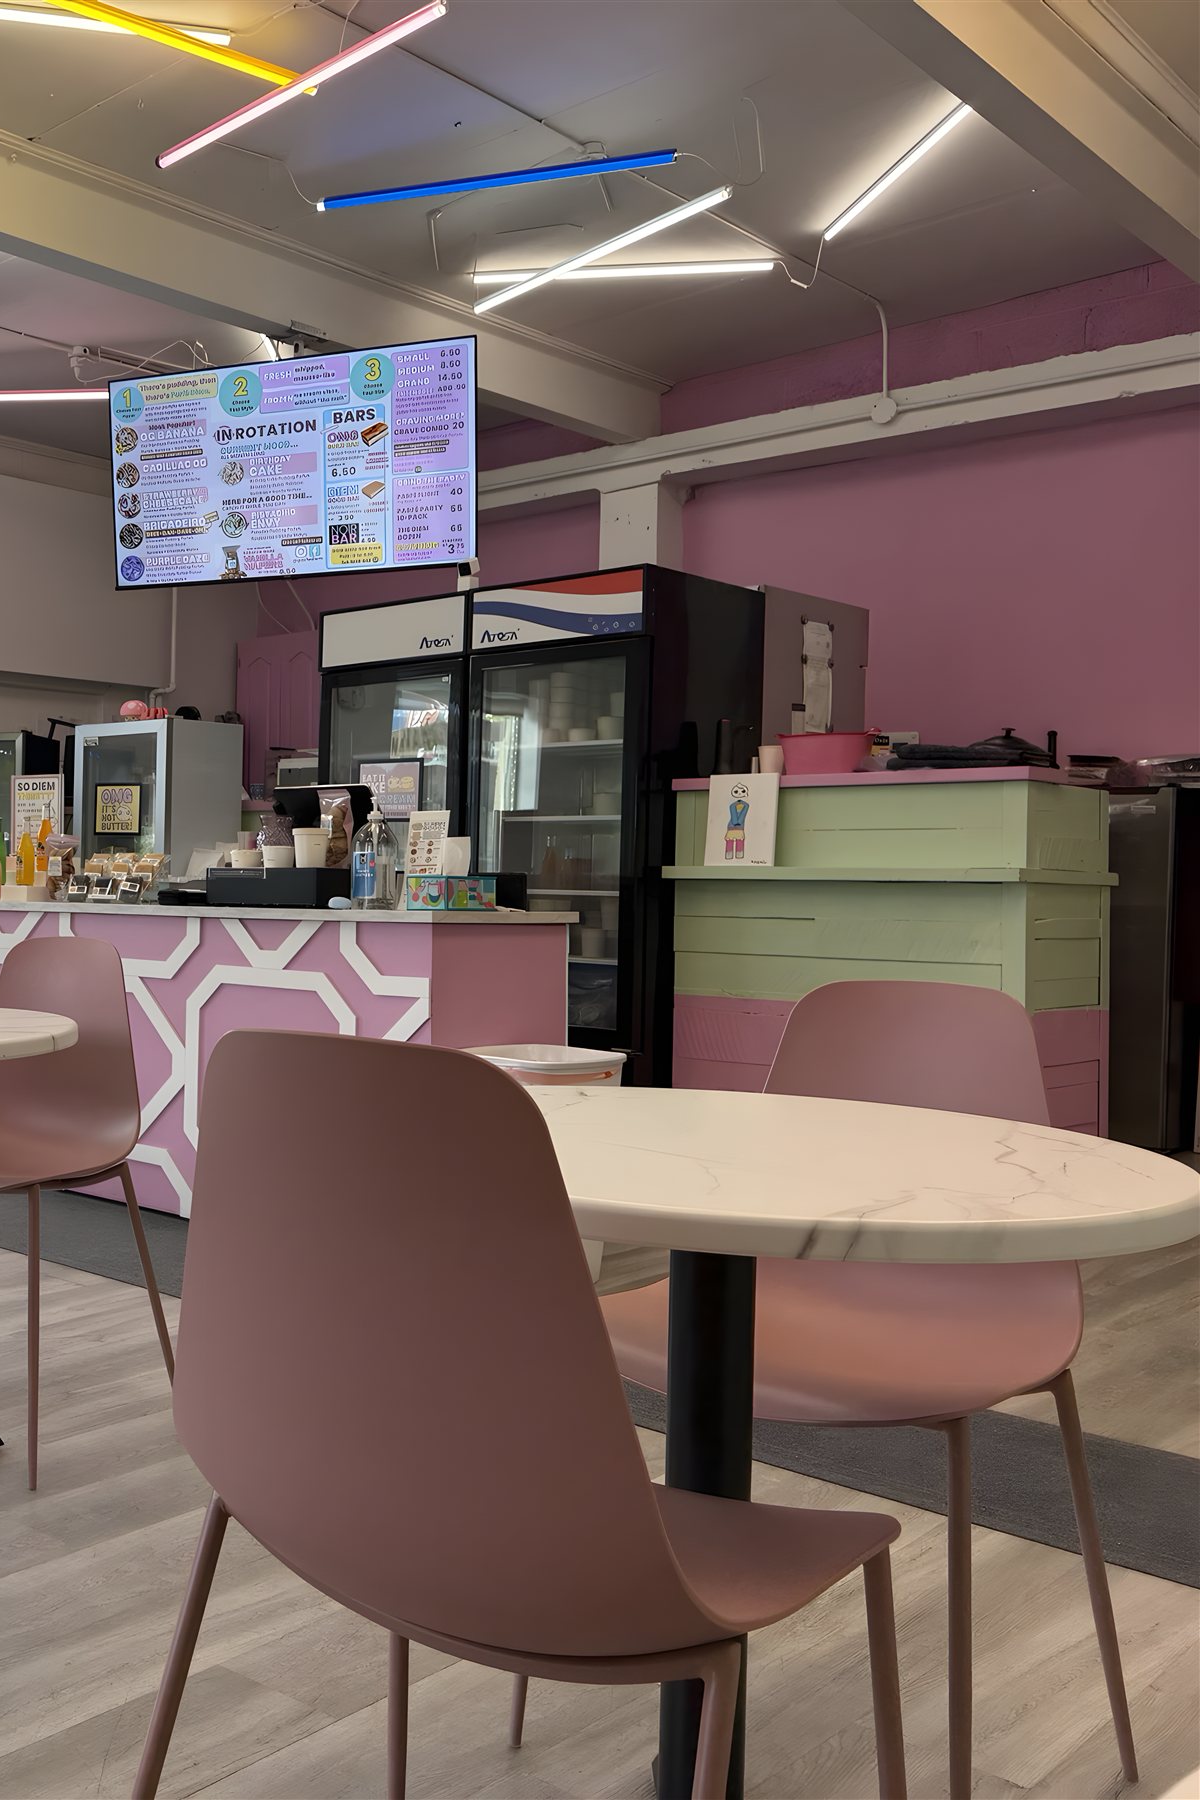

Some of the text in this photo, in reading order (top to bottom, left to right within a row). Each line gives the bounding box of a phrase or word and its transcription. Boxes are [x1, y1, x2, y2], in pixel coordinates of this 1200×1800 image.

[397, 353, 430, 363] SMALL
[264, 370, 292, 381] FRESH
[364, 358, 381, 381] 3
[397, 365, 435, 376] MEDIUM
[233, 376, 249, 397] 2
[123, 388, 131, 408] 1
[332, 408, 377, 425] BARS
[216, 419, 317, 442] IN ROTATION
[452, 421, 465, 430] 20
[157, 426, 205, 440] BANANA
[143, 461, 191, 473] CADILLAC
[249, 464, 283, 477] CAKE
[331, 466, 356, 478] 6.50
[450, 487, 463, 496] 40
[142, 496, 204, 509] CHEESECAKE
[251, 518, 281, 529] ENVY
[330, 533, 358, 545] BAR
[17, 781, 55, 791] SO DIEM
[101, 788, 132, 804] OMG
[101, 822, 132, 830] BUTTER!
